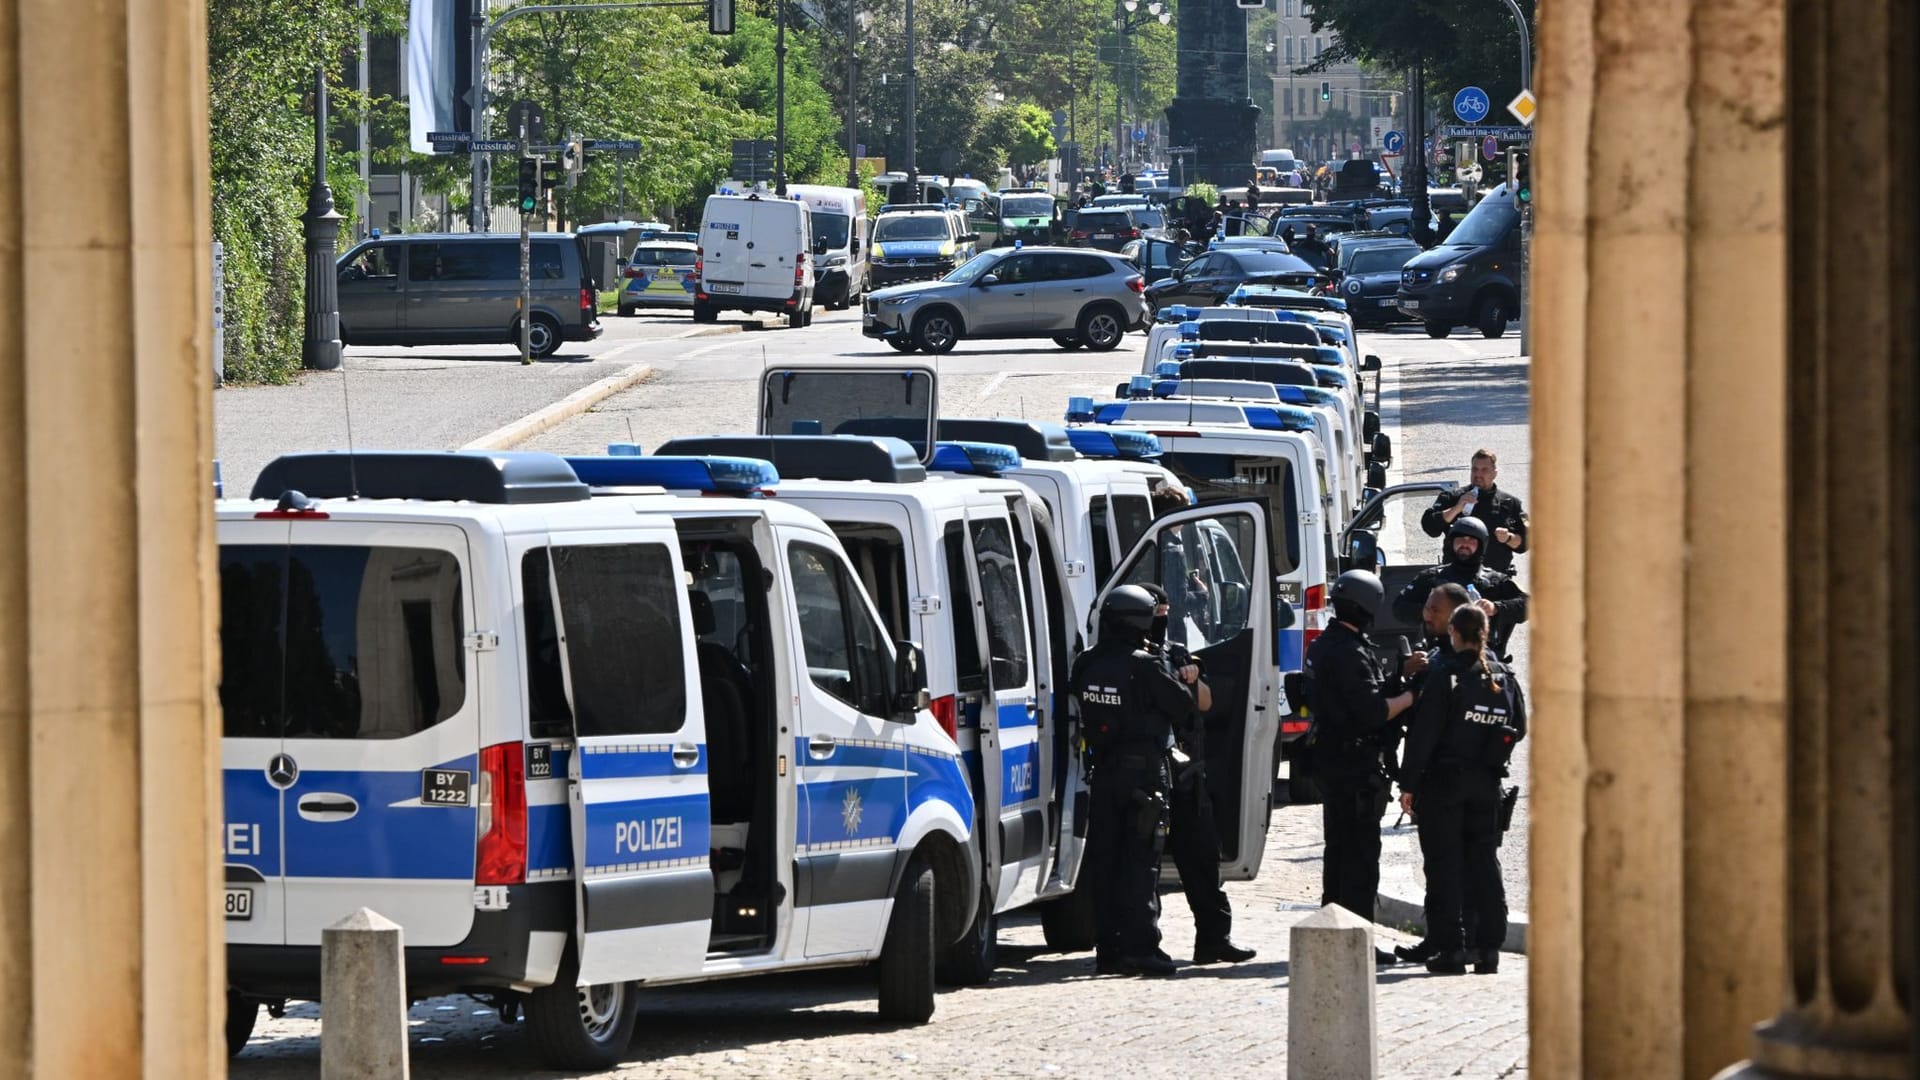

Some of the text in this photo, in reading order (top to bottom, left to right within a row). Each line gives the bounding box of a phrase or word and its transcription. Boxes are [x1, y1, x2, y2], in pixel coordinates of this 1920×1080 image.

[1451, 127, 1499, 136] Katharina-vo
[471, 142, 516, 151] Arcisstraße
[1082, 691, 1121, 705] POLIZEI
[1464, 710, 1508, 725] POLIZEI
[533, 747, 544, 759] BY
[530, 763, 550, 775] 1222
[436, 773, 456, 786] BY
[1010, 762, 1032, 793] POLIZEI
[430, 789, 466, 802] 1222
[224, 823, 260, 855] EI
[615, 815, 682, 854] POLIZEI
[225, 893, 248, 913] 80
